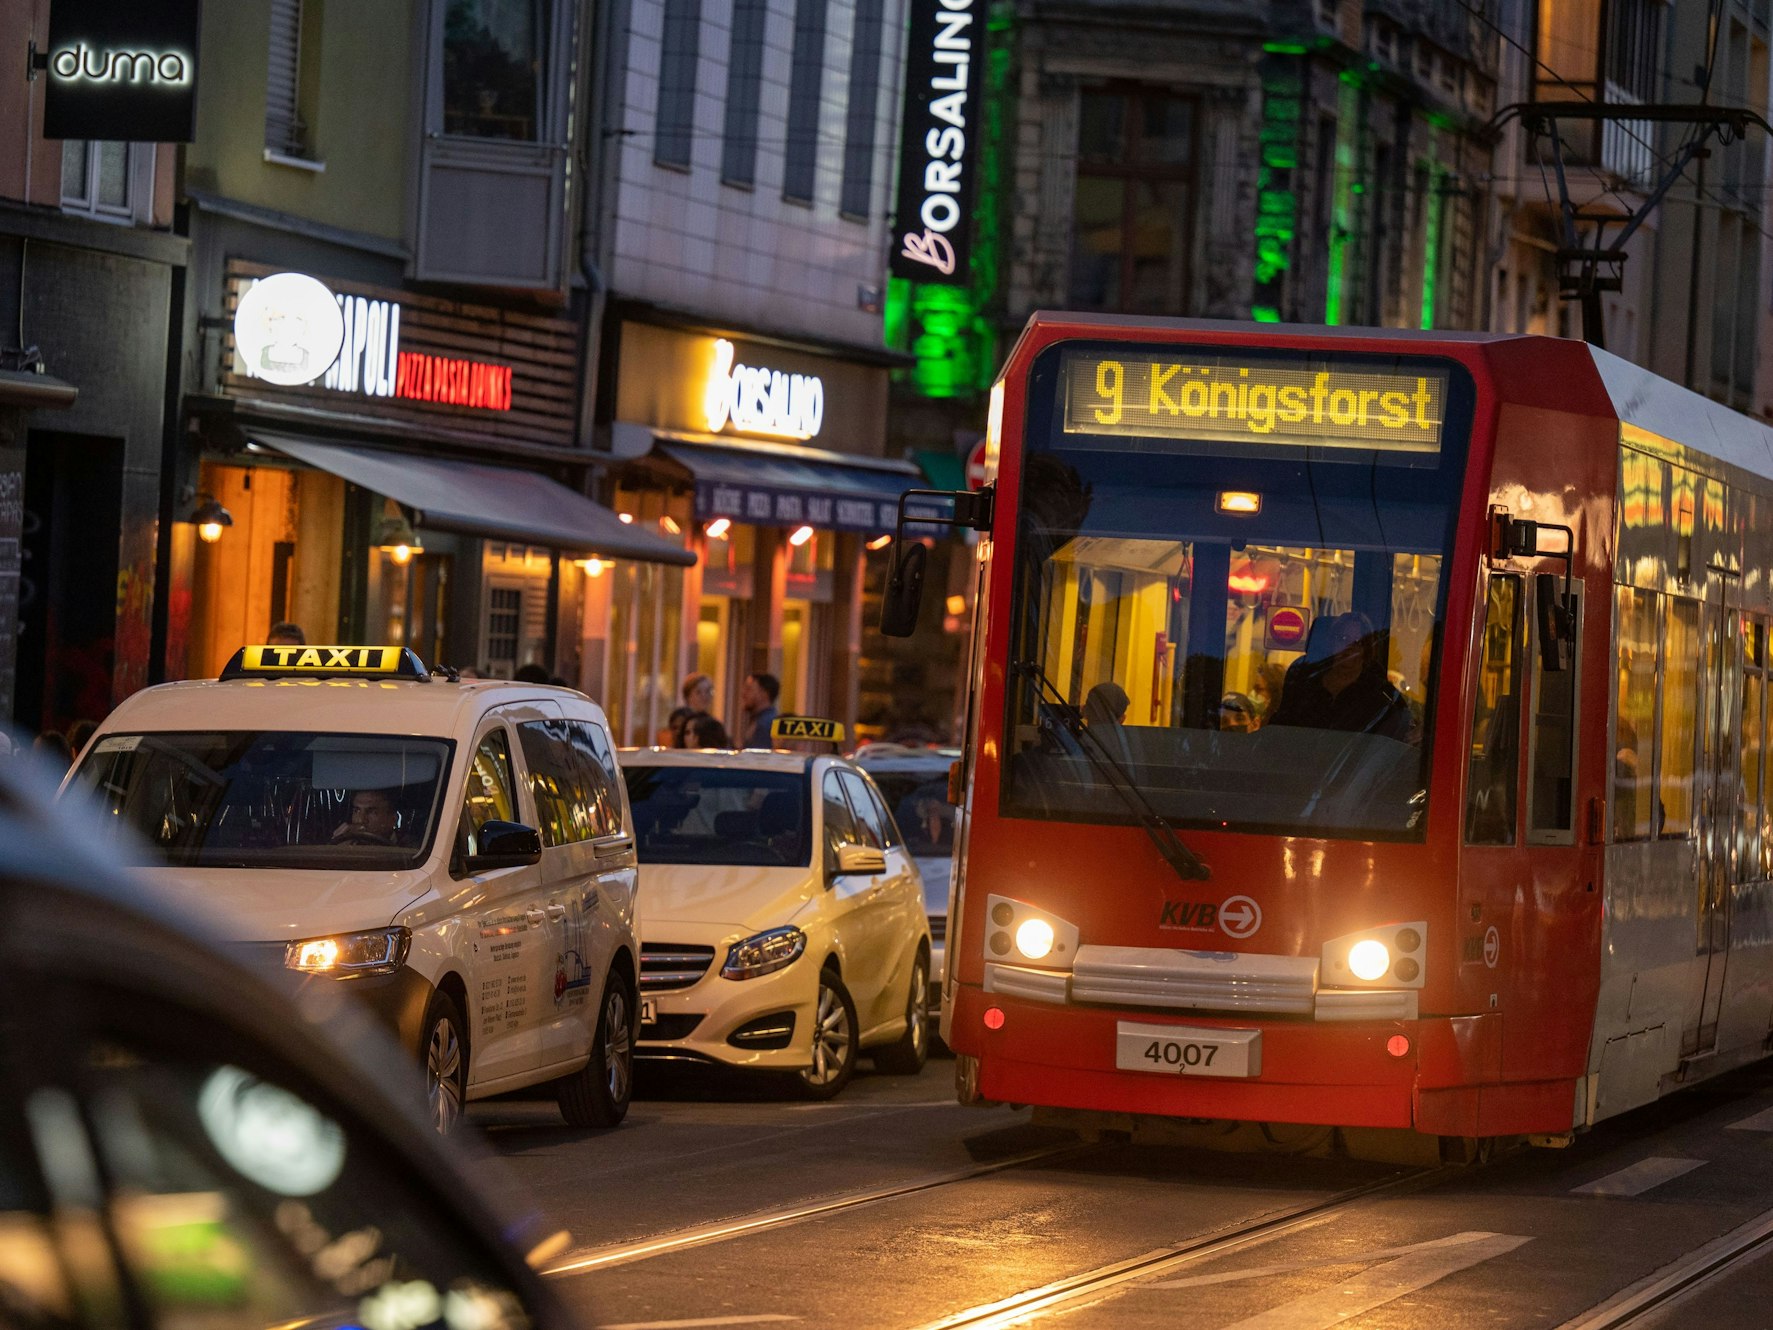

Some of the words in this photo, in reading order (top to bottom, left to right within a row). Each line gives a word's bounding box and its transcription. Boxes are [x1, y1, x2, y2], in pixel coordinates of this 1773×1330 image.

[53, 43, 188, 83] duma
[902, 0, 975, 275] BORSALIN
[396, 351, 433, 401] PIZZA
[1095, 360, 1124, 425] 9
[1149, 362, 1432, 434] Königsforst
[273, 648, 369, 667] TAXI
[783, 720, 830, 736] TAXI
[1160, 900, 1217, 927] KVB
[1144, 1041, 1218, 1066] 4007
